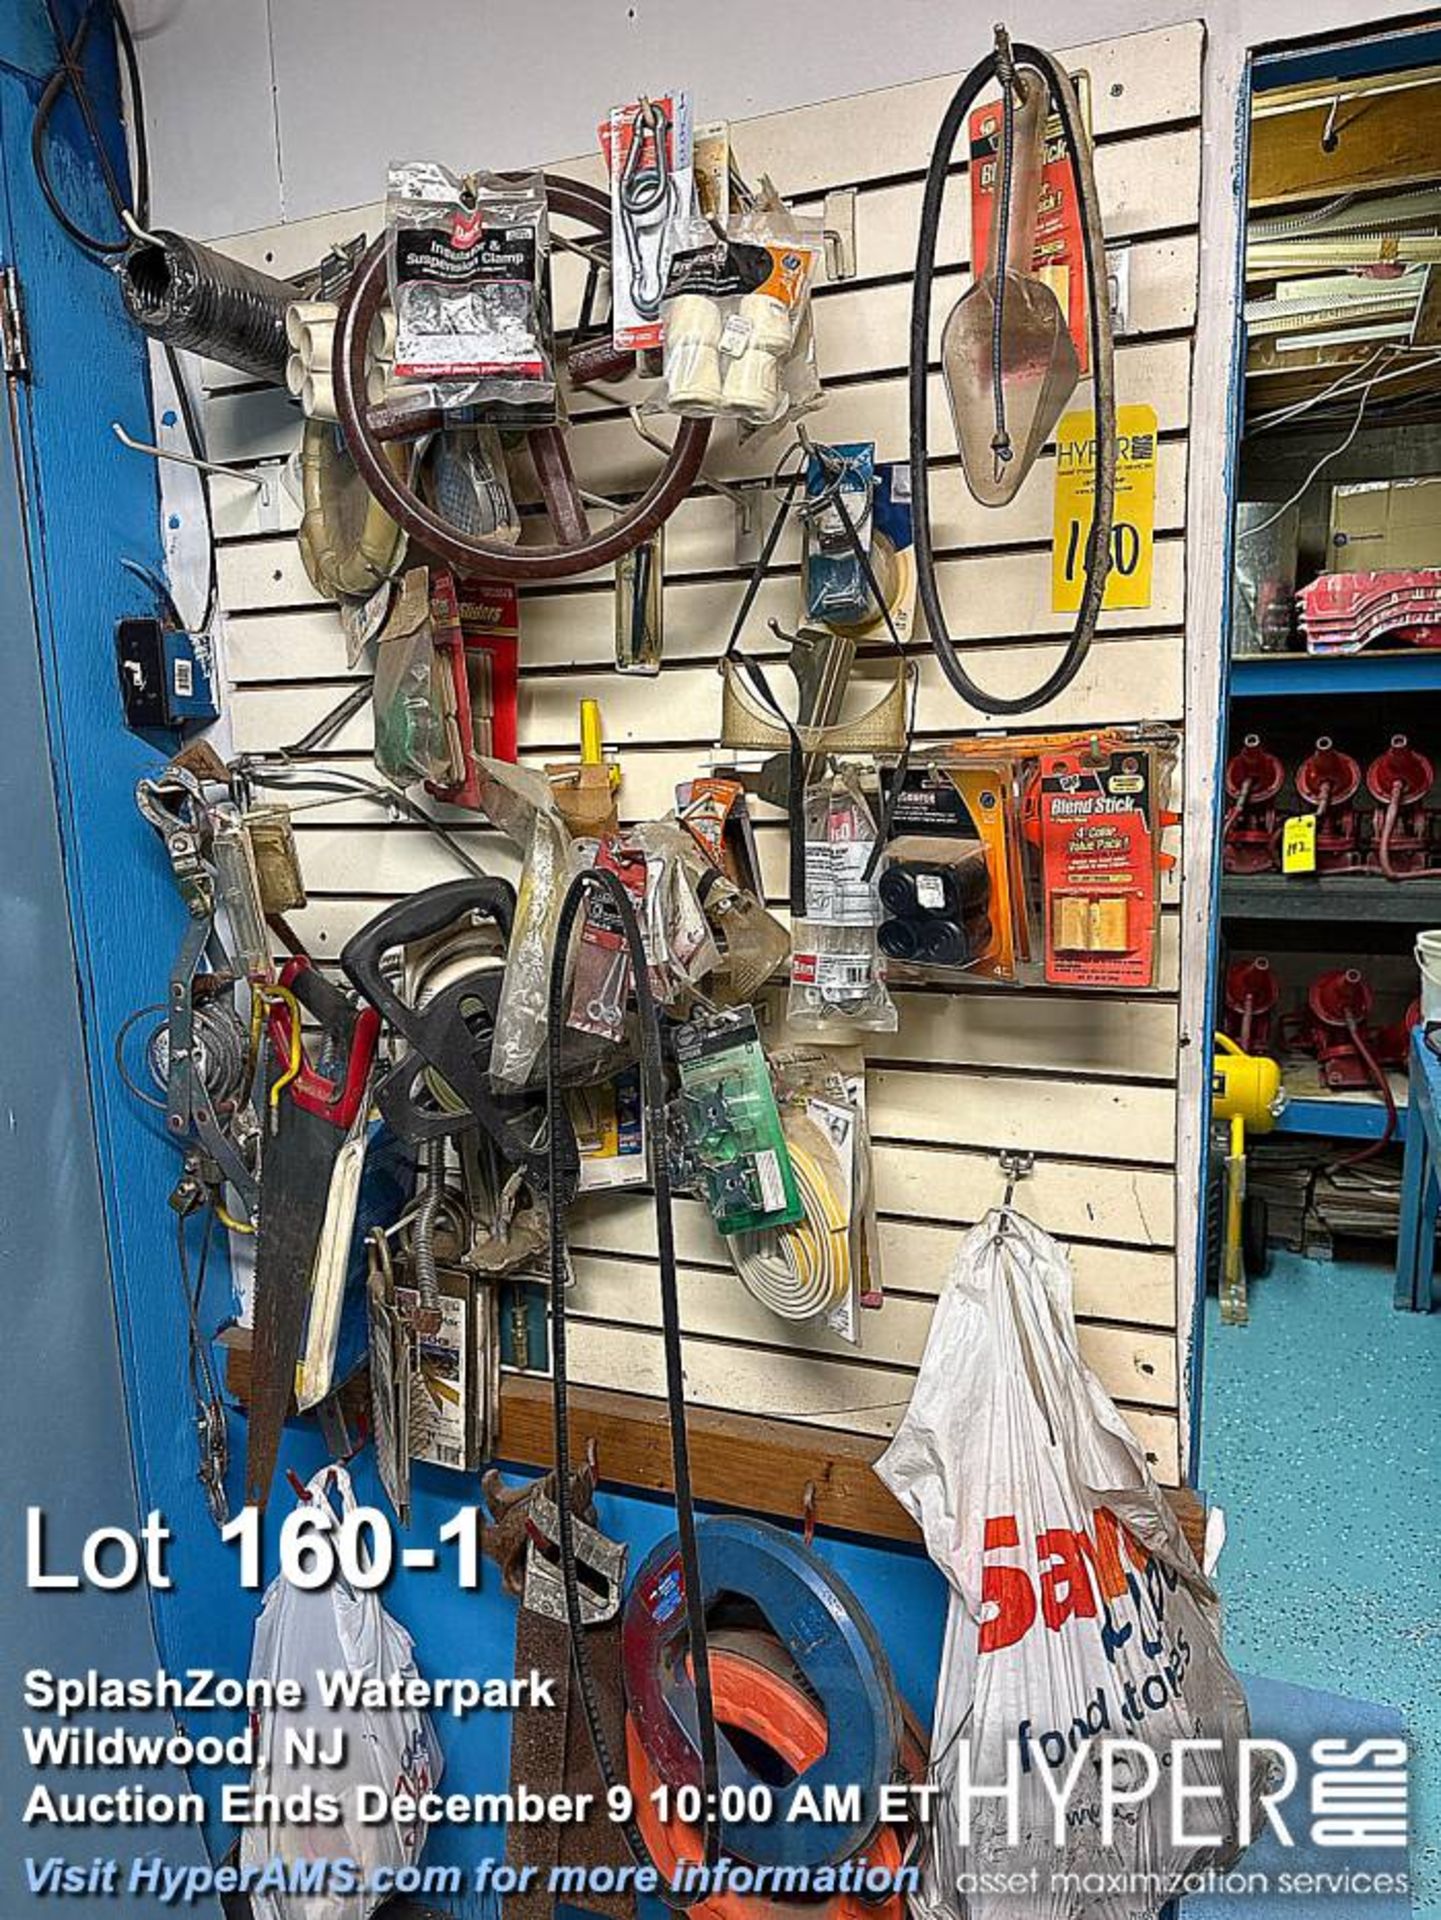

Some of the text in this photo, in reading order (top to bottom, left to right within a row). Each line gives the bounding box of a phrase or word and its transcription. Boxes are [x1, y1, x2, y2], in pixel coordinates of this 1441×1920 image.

[489, 240, 502, 251] &
[405, 253, 479, 272] Suspension
[481, 252, 524, 266] Clamp
[1058, 437, 1129, 466] HYPR
[1051, 795, 1135, 815] Blend Stick
